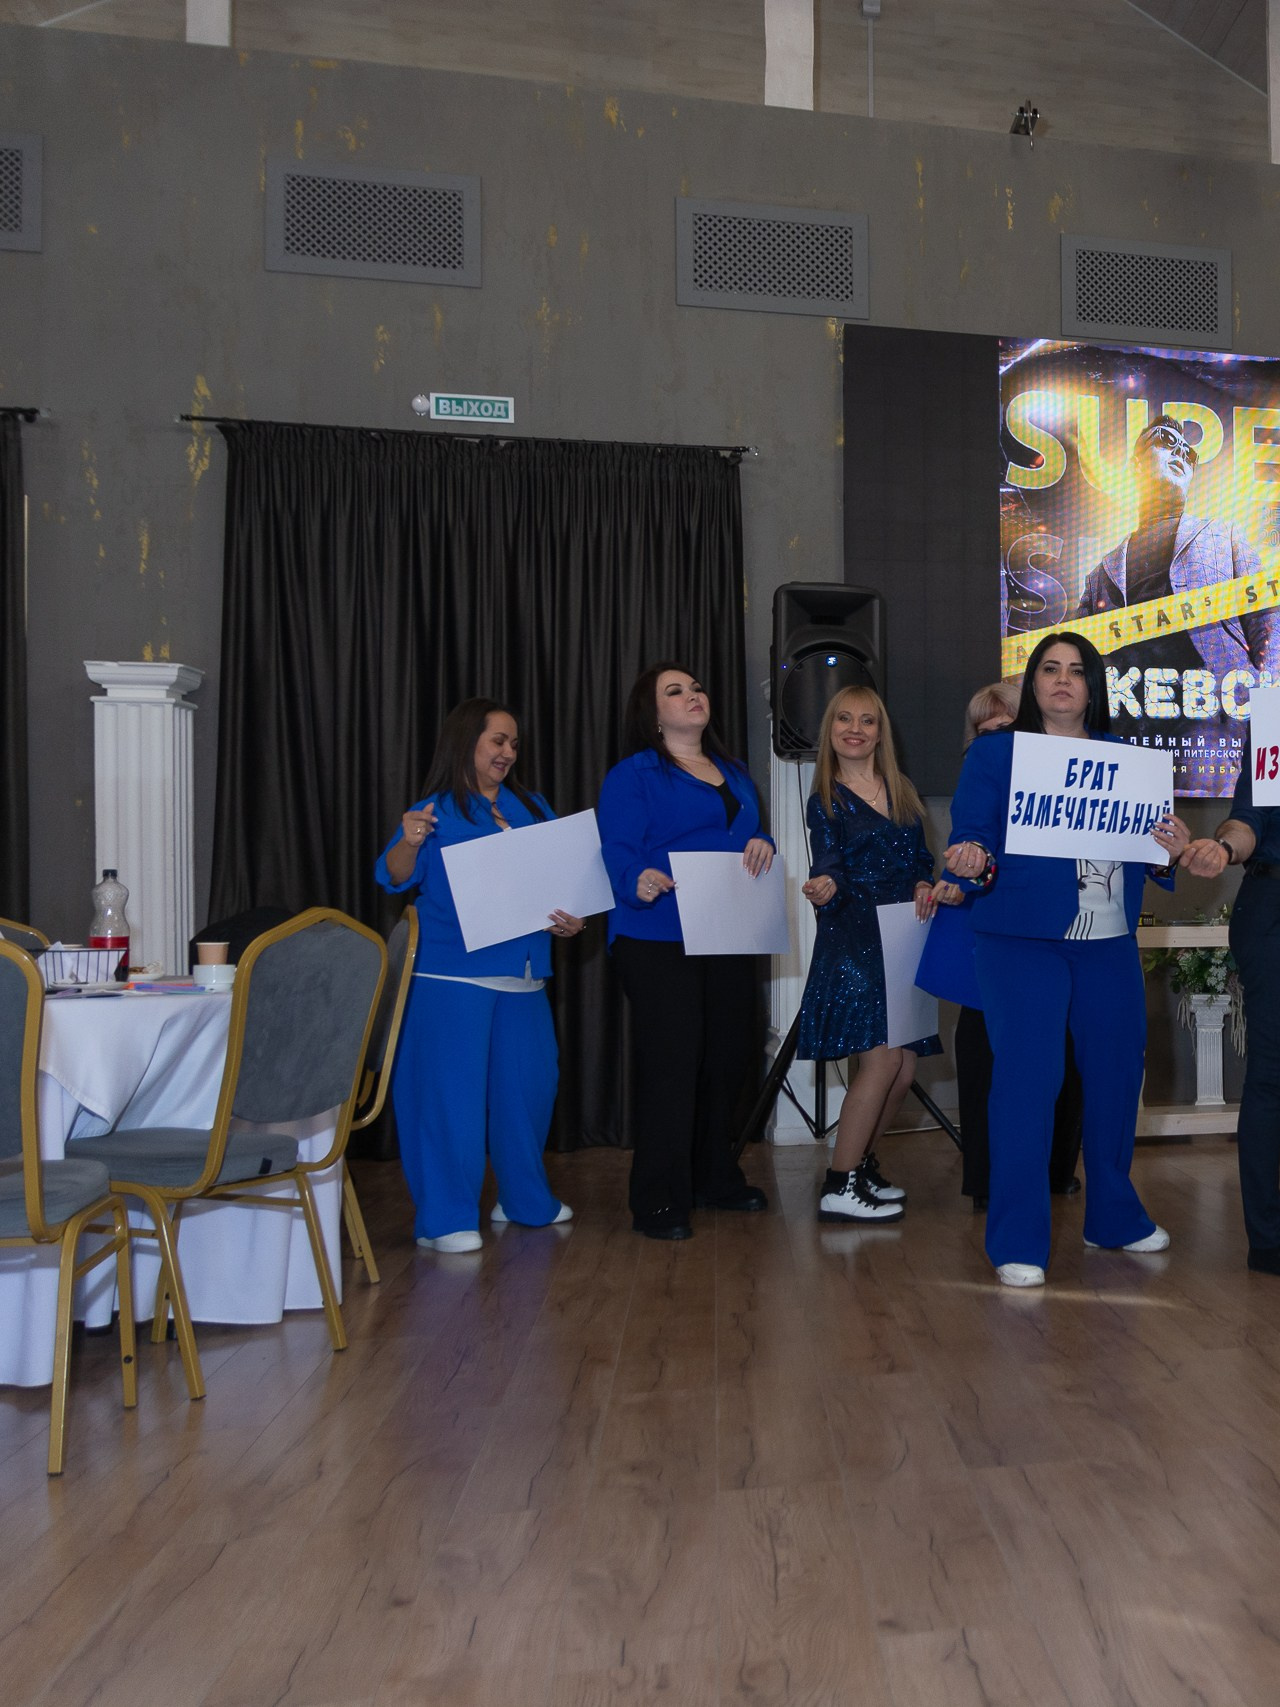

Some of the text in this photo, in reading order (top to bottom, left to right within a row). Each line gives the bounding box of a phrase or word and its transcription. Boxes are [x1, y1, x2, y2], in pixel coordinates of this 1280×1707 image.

[438, 399, 506, 418] ВЫХОД
[1128, 735, 1205, 748] ЛЕЙНЫЙ
[1184, 748, 1243, 759] ПИТЕРСКОГ
[1064, 757, 1119, 792] БРАТ
[1198, 765, 1242, 774] ИЗБР
